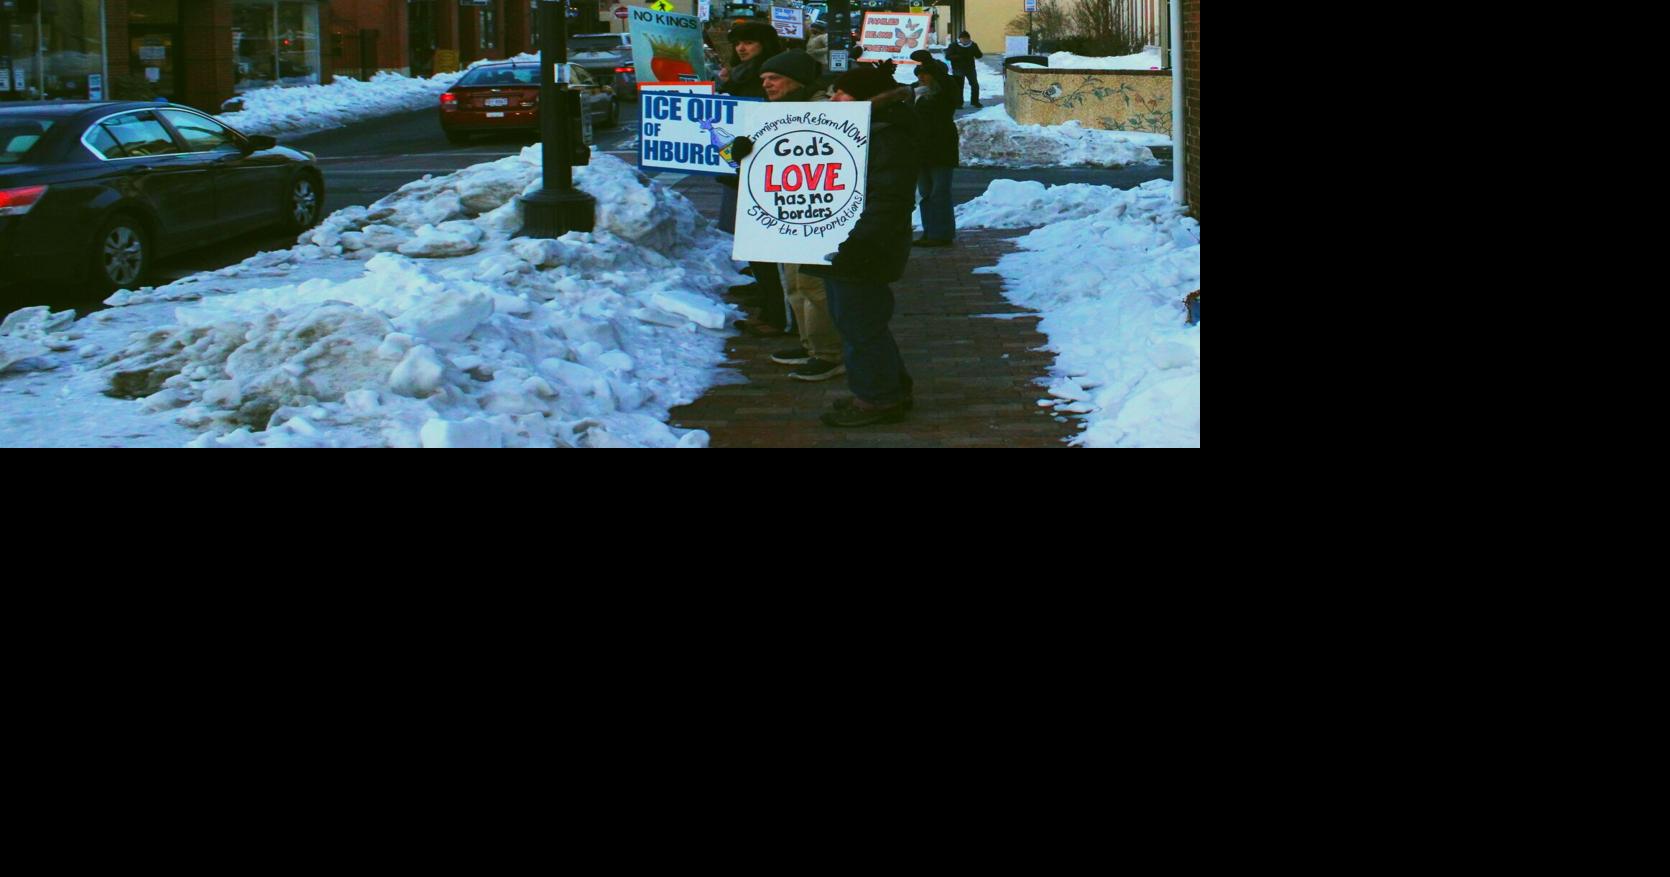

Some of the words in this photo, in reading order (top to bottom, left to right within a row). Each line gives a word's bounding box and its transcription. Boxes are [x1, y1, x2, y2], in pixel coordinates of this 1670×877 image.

[633, 10, 653, 22] NO
[656, 14, 697, 29] KINGS
[644, 96, 682, 120] ICE
[687, 98, 738, 124] OUT
[644, 122, 661, 136] OF
[803, 112, 839, 130] Reform
[838, 120, 868, 148] NOW!
[644, 140, 720, 166] HBURG
[774, 137, 834, 156] God's
[764, 163, 846, 192] LOVE
[774, 192, 806, 206] has
[809, 192, 834, 204] no
[747, 205, 778, 229] STOP
[780, 224, 798, 236] the
[778, 204, 832, 220] borders
